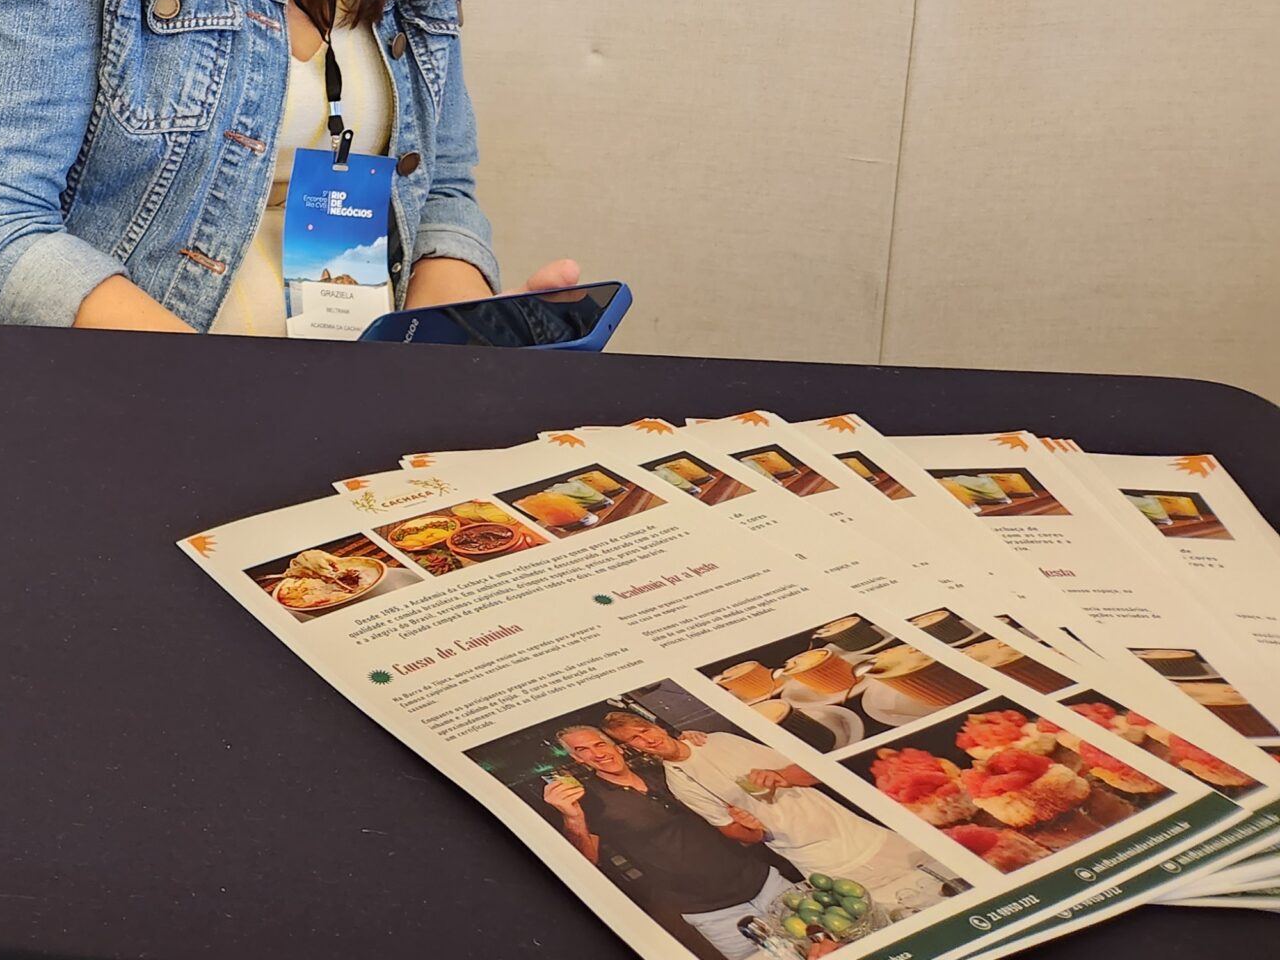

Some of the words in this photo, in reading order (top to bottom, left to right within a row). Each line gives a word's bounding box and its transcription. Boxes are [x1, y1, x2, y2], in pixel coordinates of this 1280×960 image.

[331, 191, 347, 200] RIO
[331, 199, 343, 207] DE
[330, 206, 373, 218] NEGÓCIOS
[320, 289, 354, 300] GRAZIELA
[381, 490, 434, 509] CACHAÇA
[392, 657, 435, 675] Curso
[435, 647, 457, 659] de
[454, 625, 523, 651] Caipirinha
[986, 911, 1003, 922] 21
